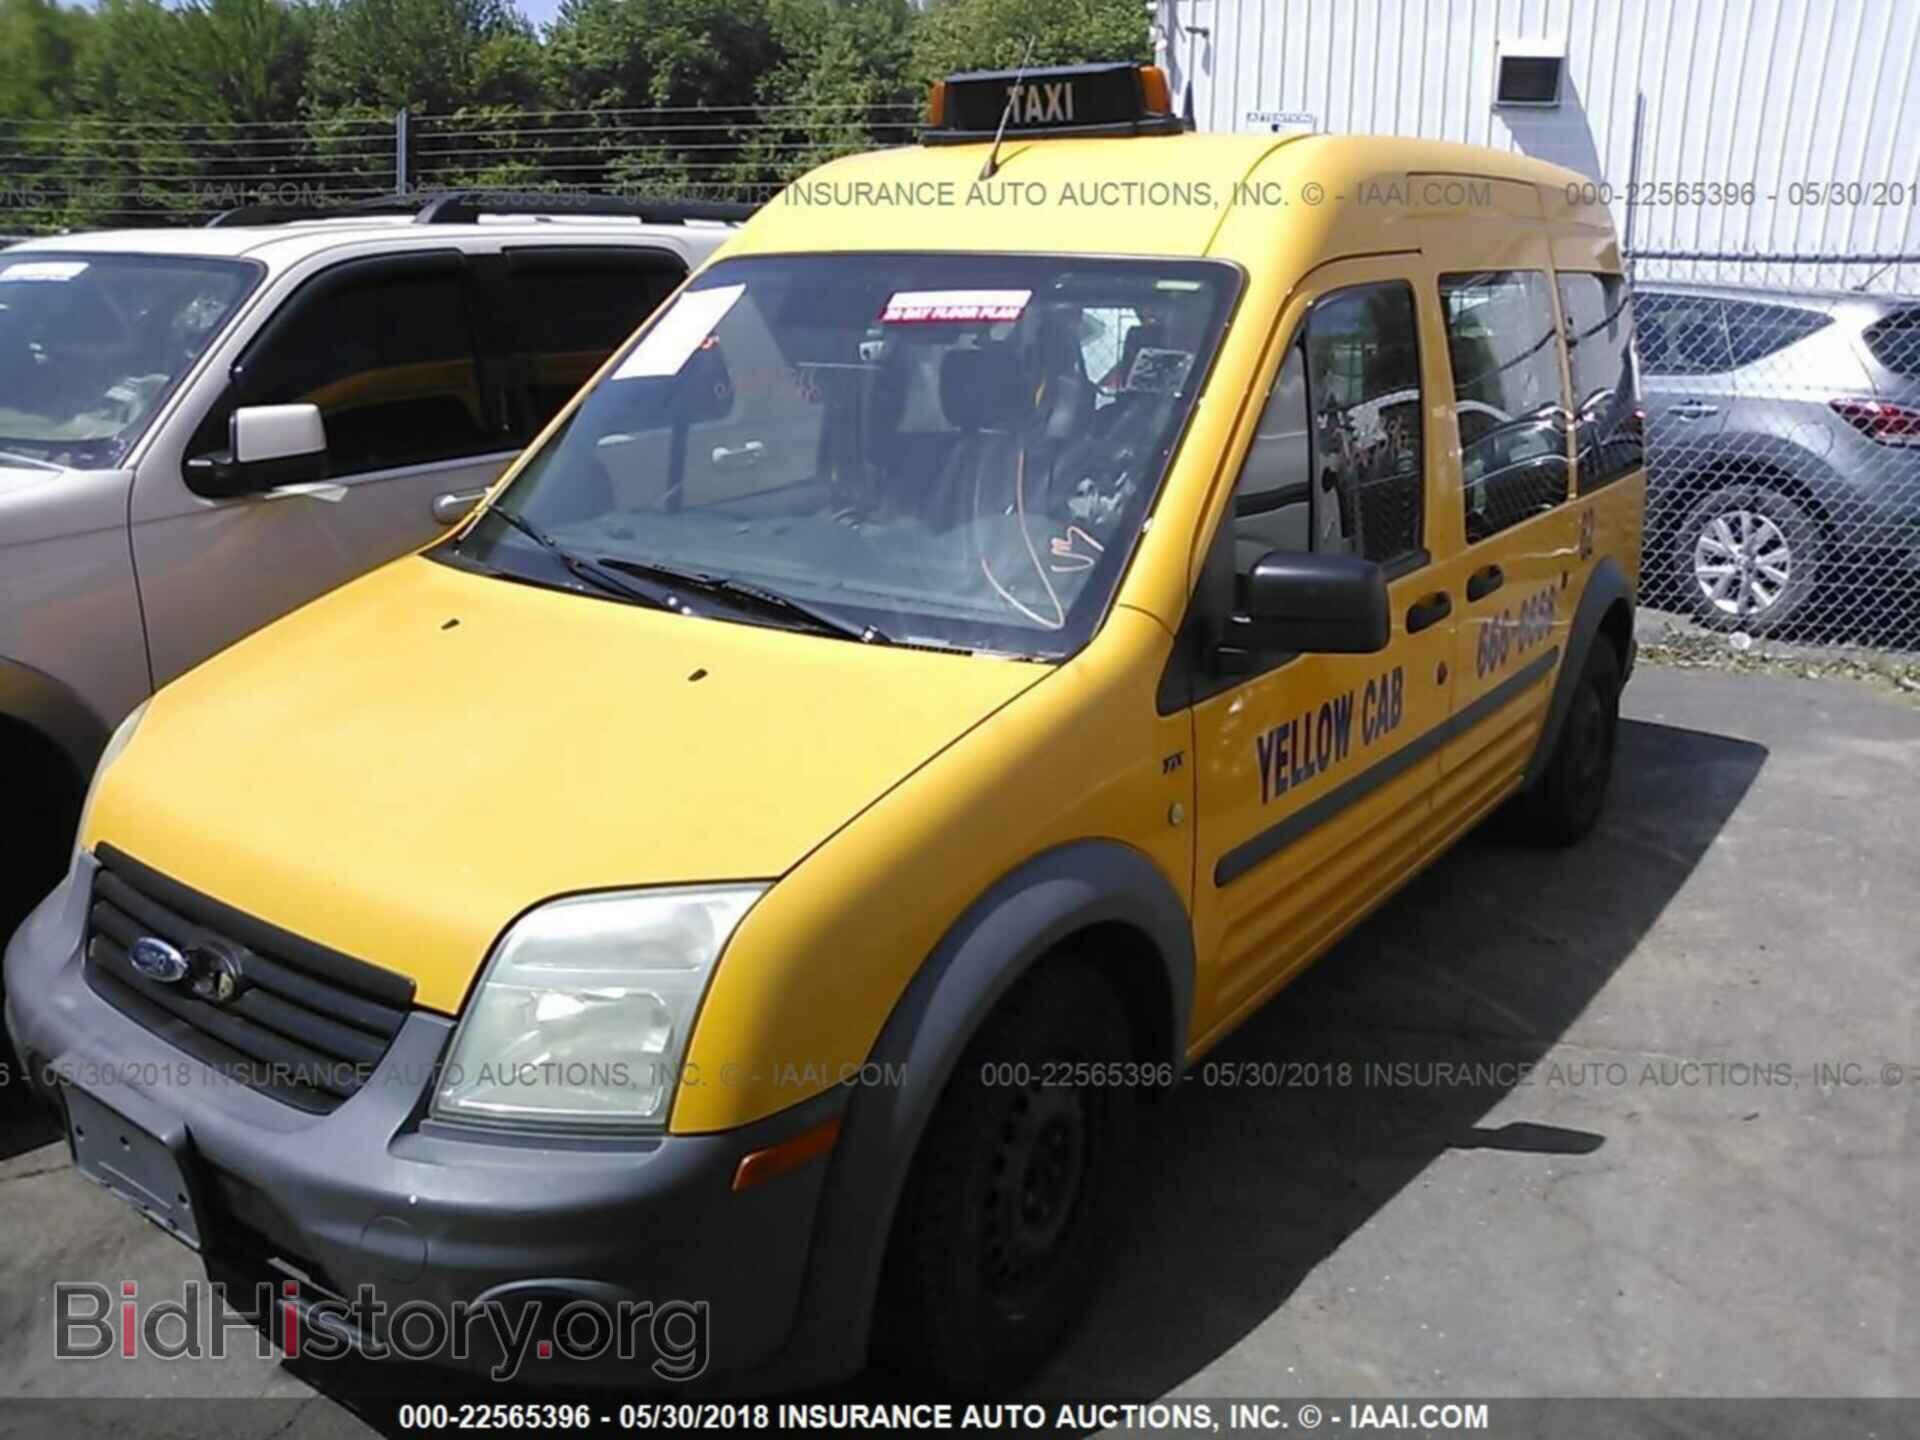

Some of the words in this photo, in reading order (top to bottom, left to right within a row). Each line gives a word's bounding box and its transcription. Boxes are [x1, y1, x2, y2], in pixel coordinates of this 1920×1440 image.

[1007, 82, 1073, 123] TAXI
[1256, 690, 1354, 805] YELLOW
[1362, 665, 1404, 747] CAB
